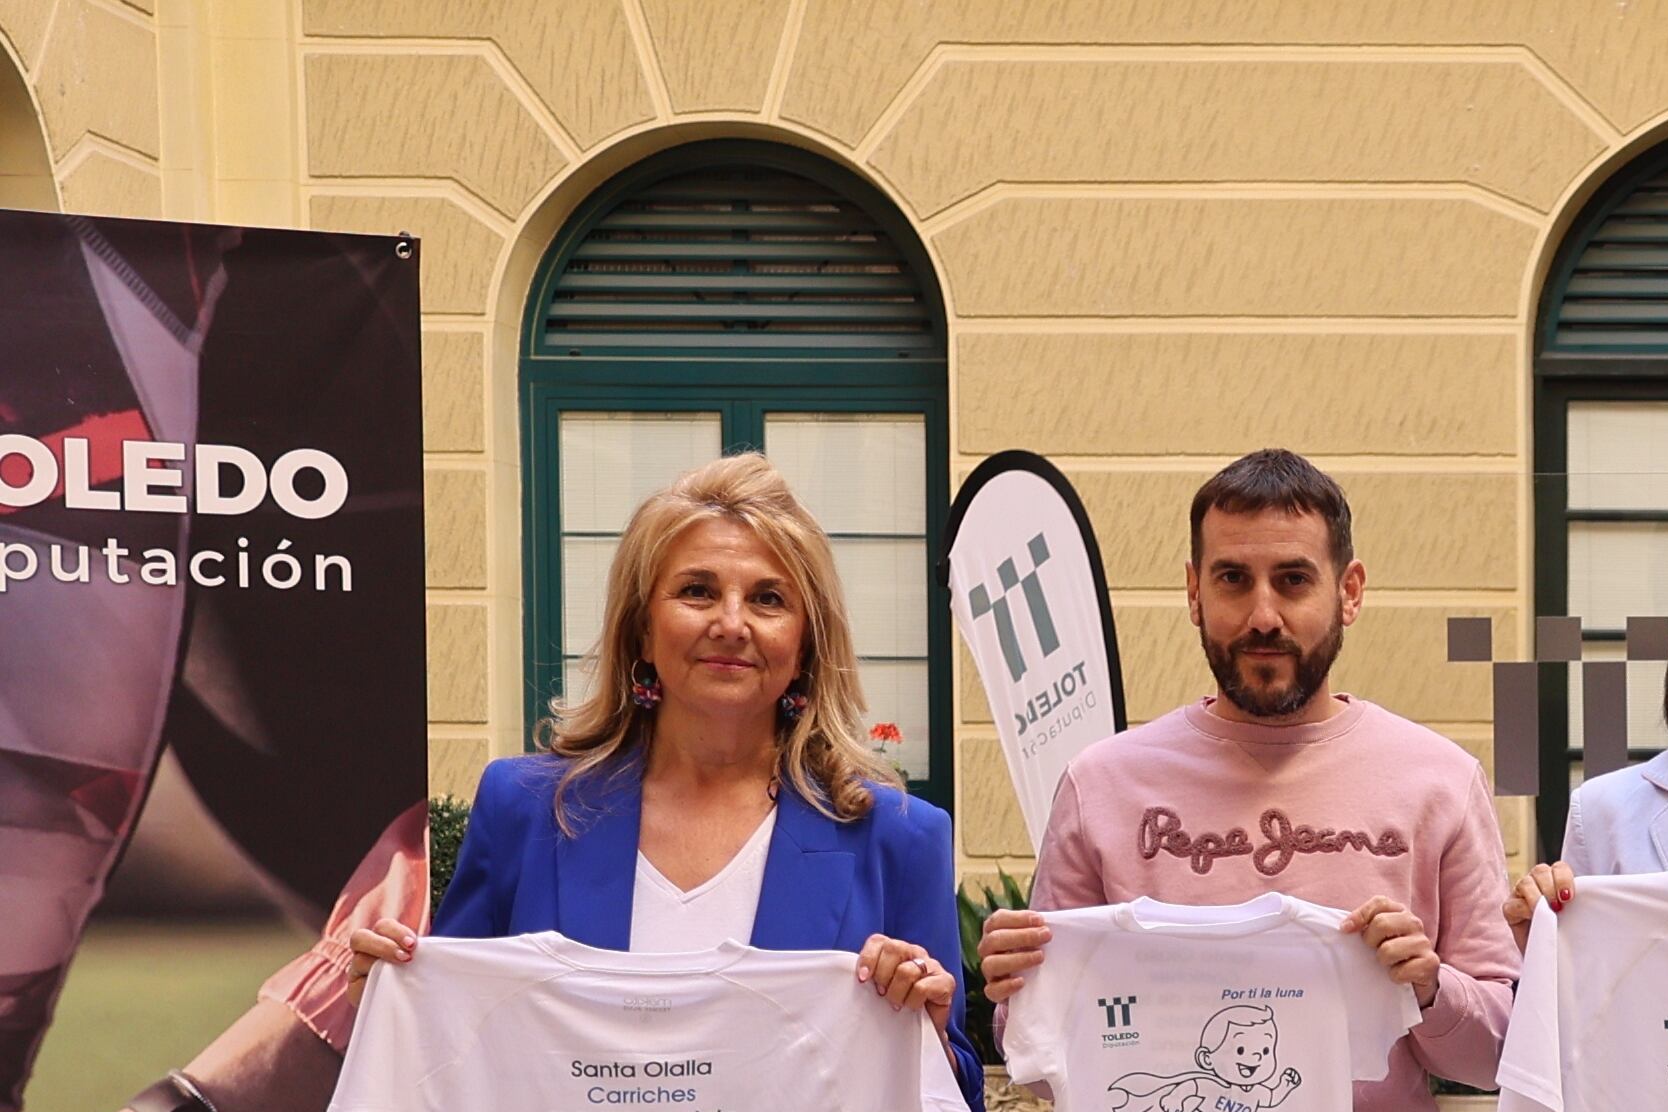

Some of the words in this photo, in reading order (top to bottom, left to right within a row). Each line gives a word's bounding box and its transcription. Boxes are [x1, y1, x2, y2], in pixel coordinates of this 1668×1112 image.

[1137, 806, 1254, 875] Pepe
[1221, 989, 1245, 1000] Por
[1248, 989, 1257, 998] ti
[1260, 988, 1272, 998] la
[1276, 988, 1303, 998] luna
[1102, 1032, 1139, 1042] TOLEDO
[571, 1060, 636, 1078] Santa
[644, 1060, 712, 1077] Olalla
[587, 1087, 696, 1103] Carriches
